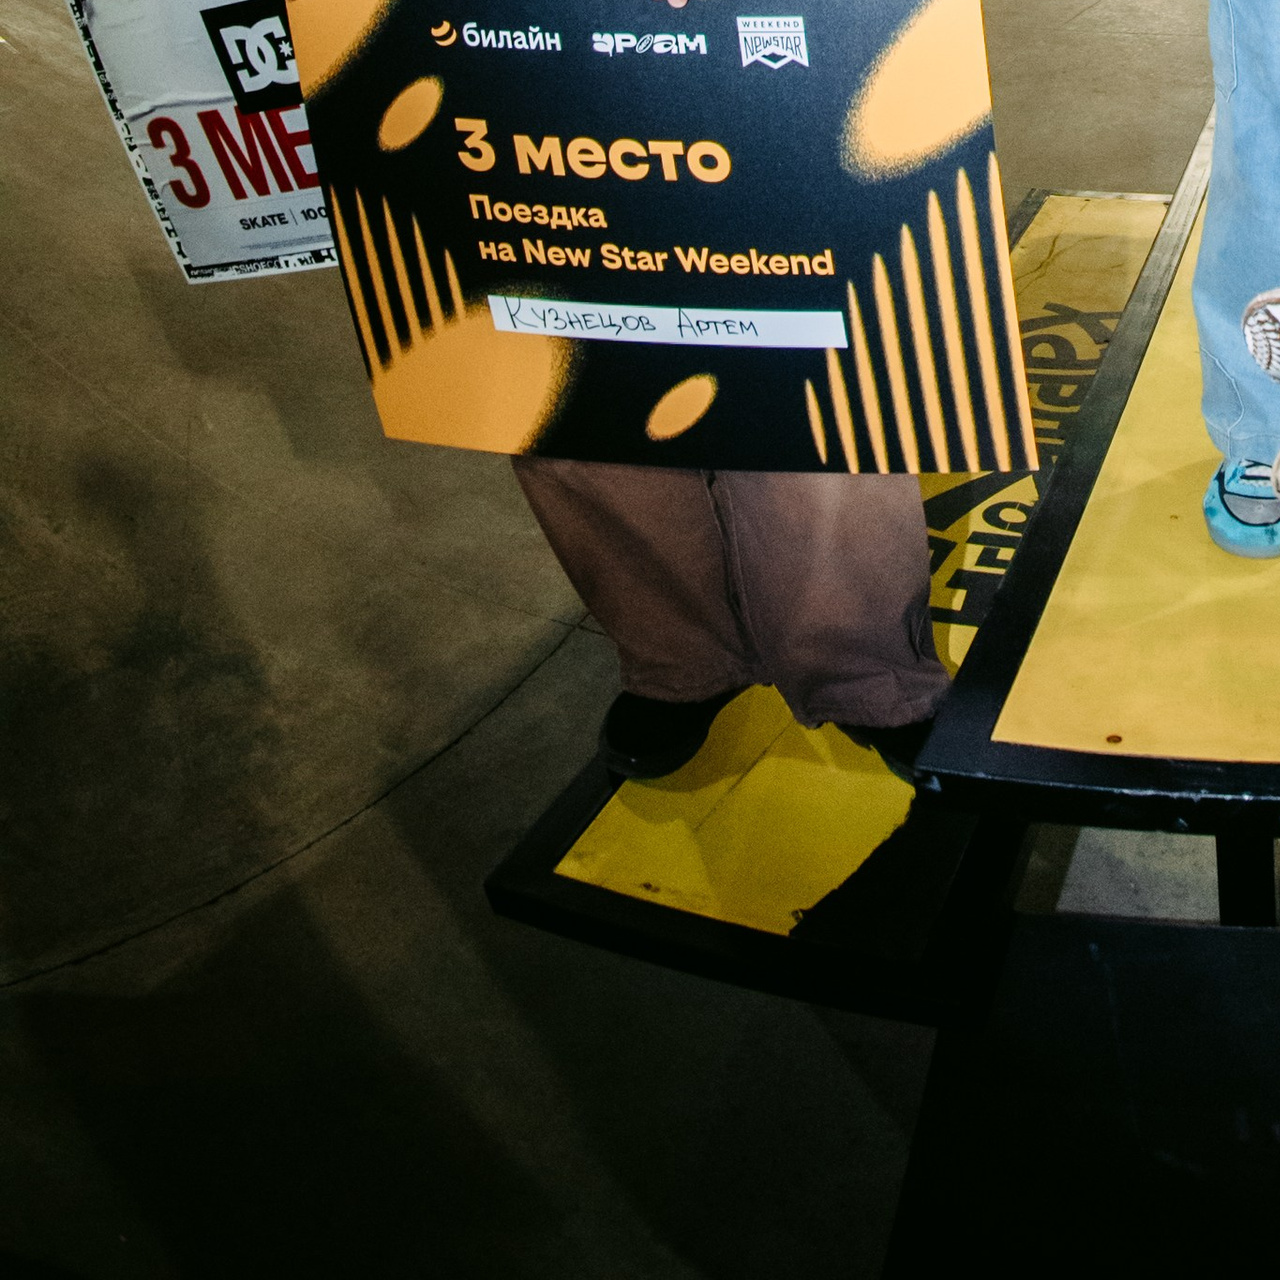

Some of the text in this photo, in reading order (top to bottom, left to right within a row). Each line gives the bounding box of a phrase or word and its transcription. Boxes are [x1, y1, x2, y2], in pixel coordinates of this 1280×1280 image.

[463, 22, 562, 51] билайн
[742, 20, 800, 29] WEEKEND
[147, 117, 211, 209] 3
[454, 117, 732, 183] 3 место
[239, 212, 289, 230] SKATE
[469, 194, 607, 230] Поездка
[478, 239, 835, 276] на New Star Weekend
